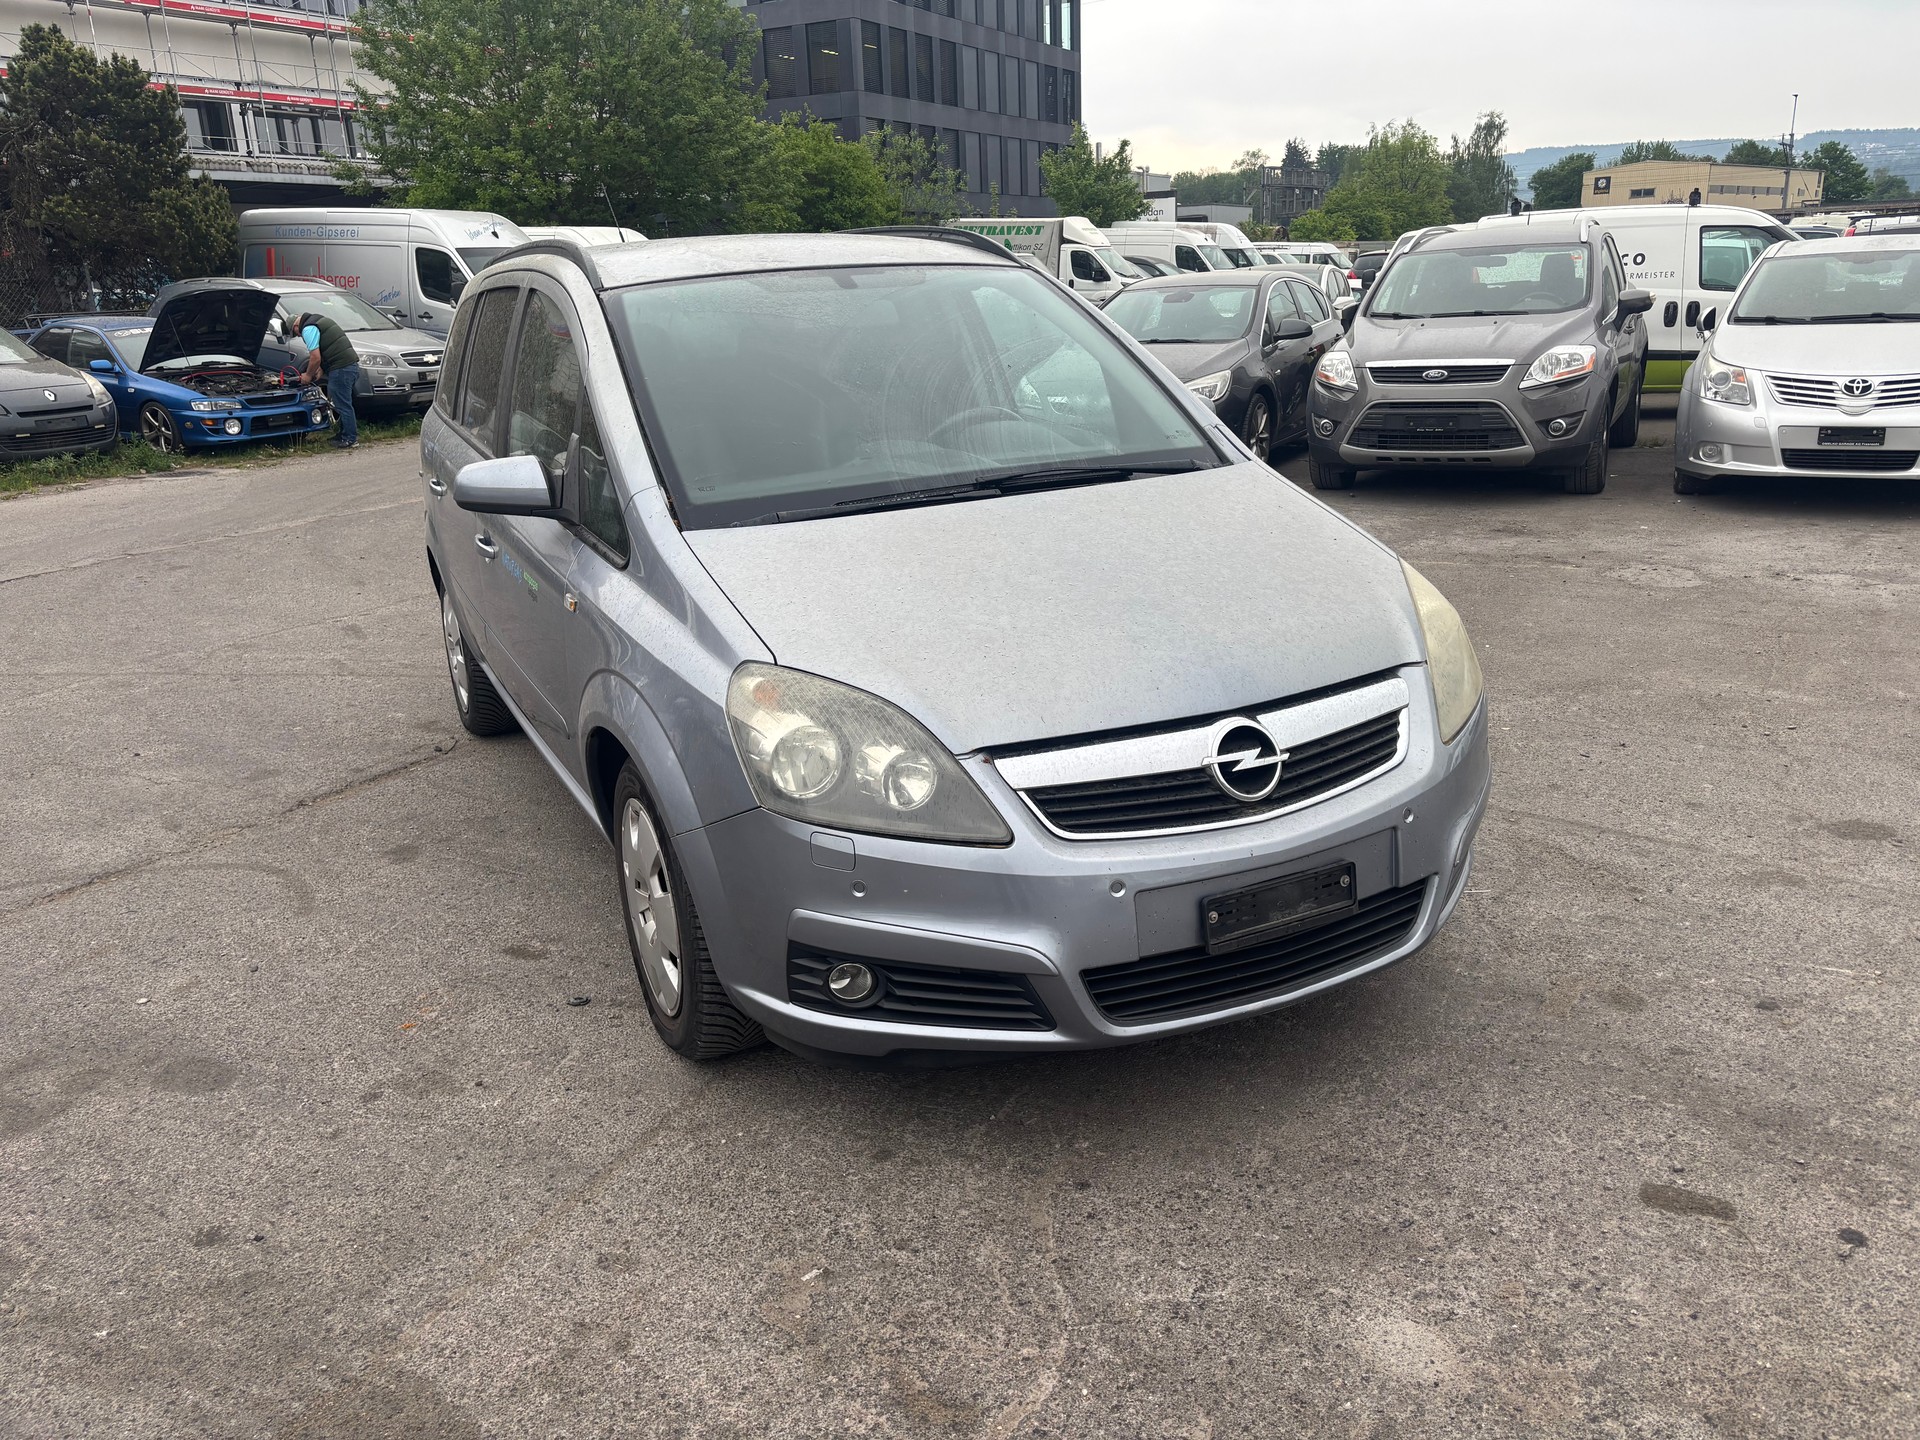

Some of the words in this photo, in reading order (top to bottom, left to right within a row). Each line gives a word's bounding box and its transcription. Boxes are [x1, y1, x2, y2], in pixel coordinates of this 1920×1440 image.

[275, 226, 360, 239] Kunden-Gipserei
[954, 225, 1044, 236] ETRAVEST
[1033, 243, 1044, 251] SZ
[1627, 271, 1675, 280] RMEISTER
